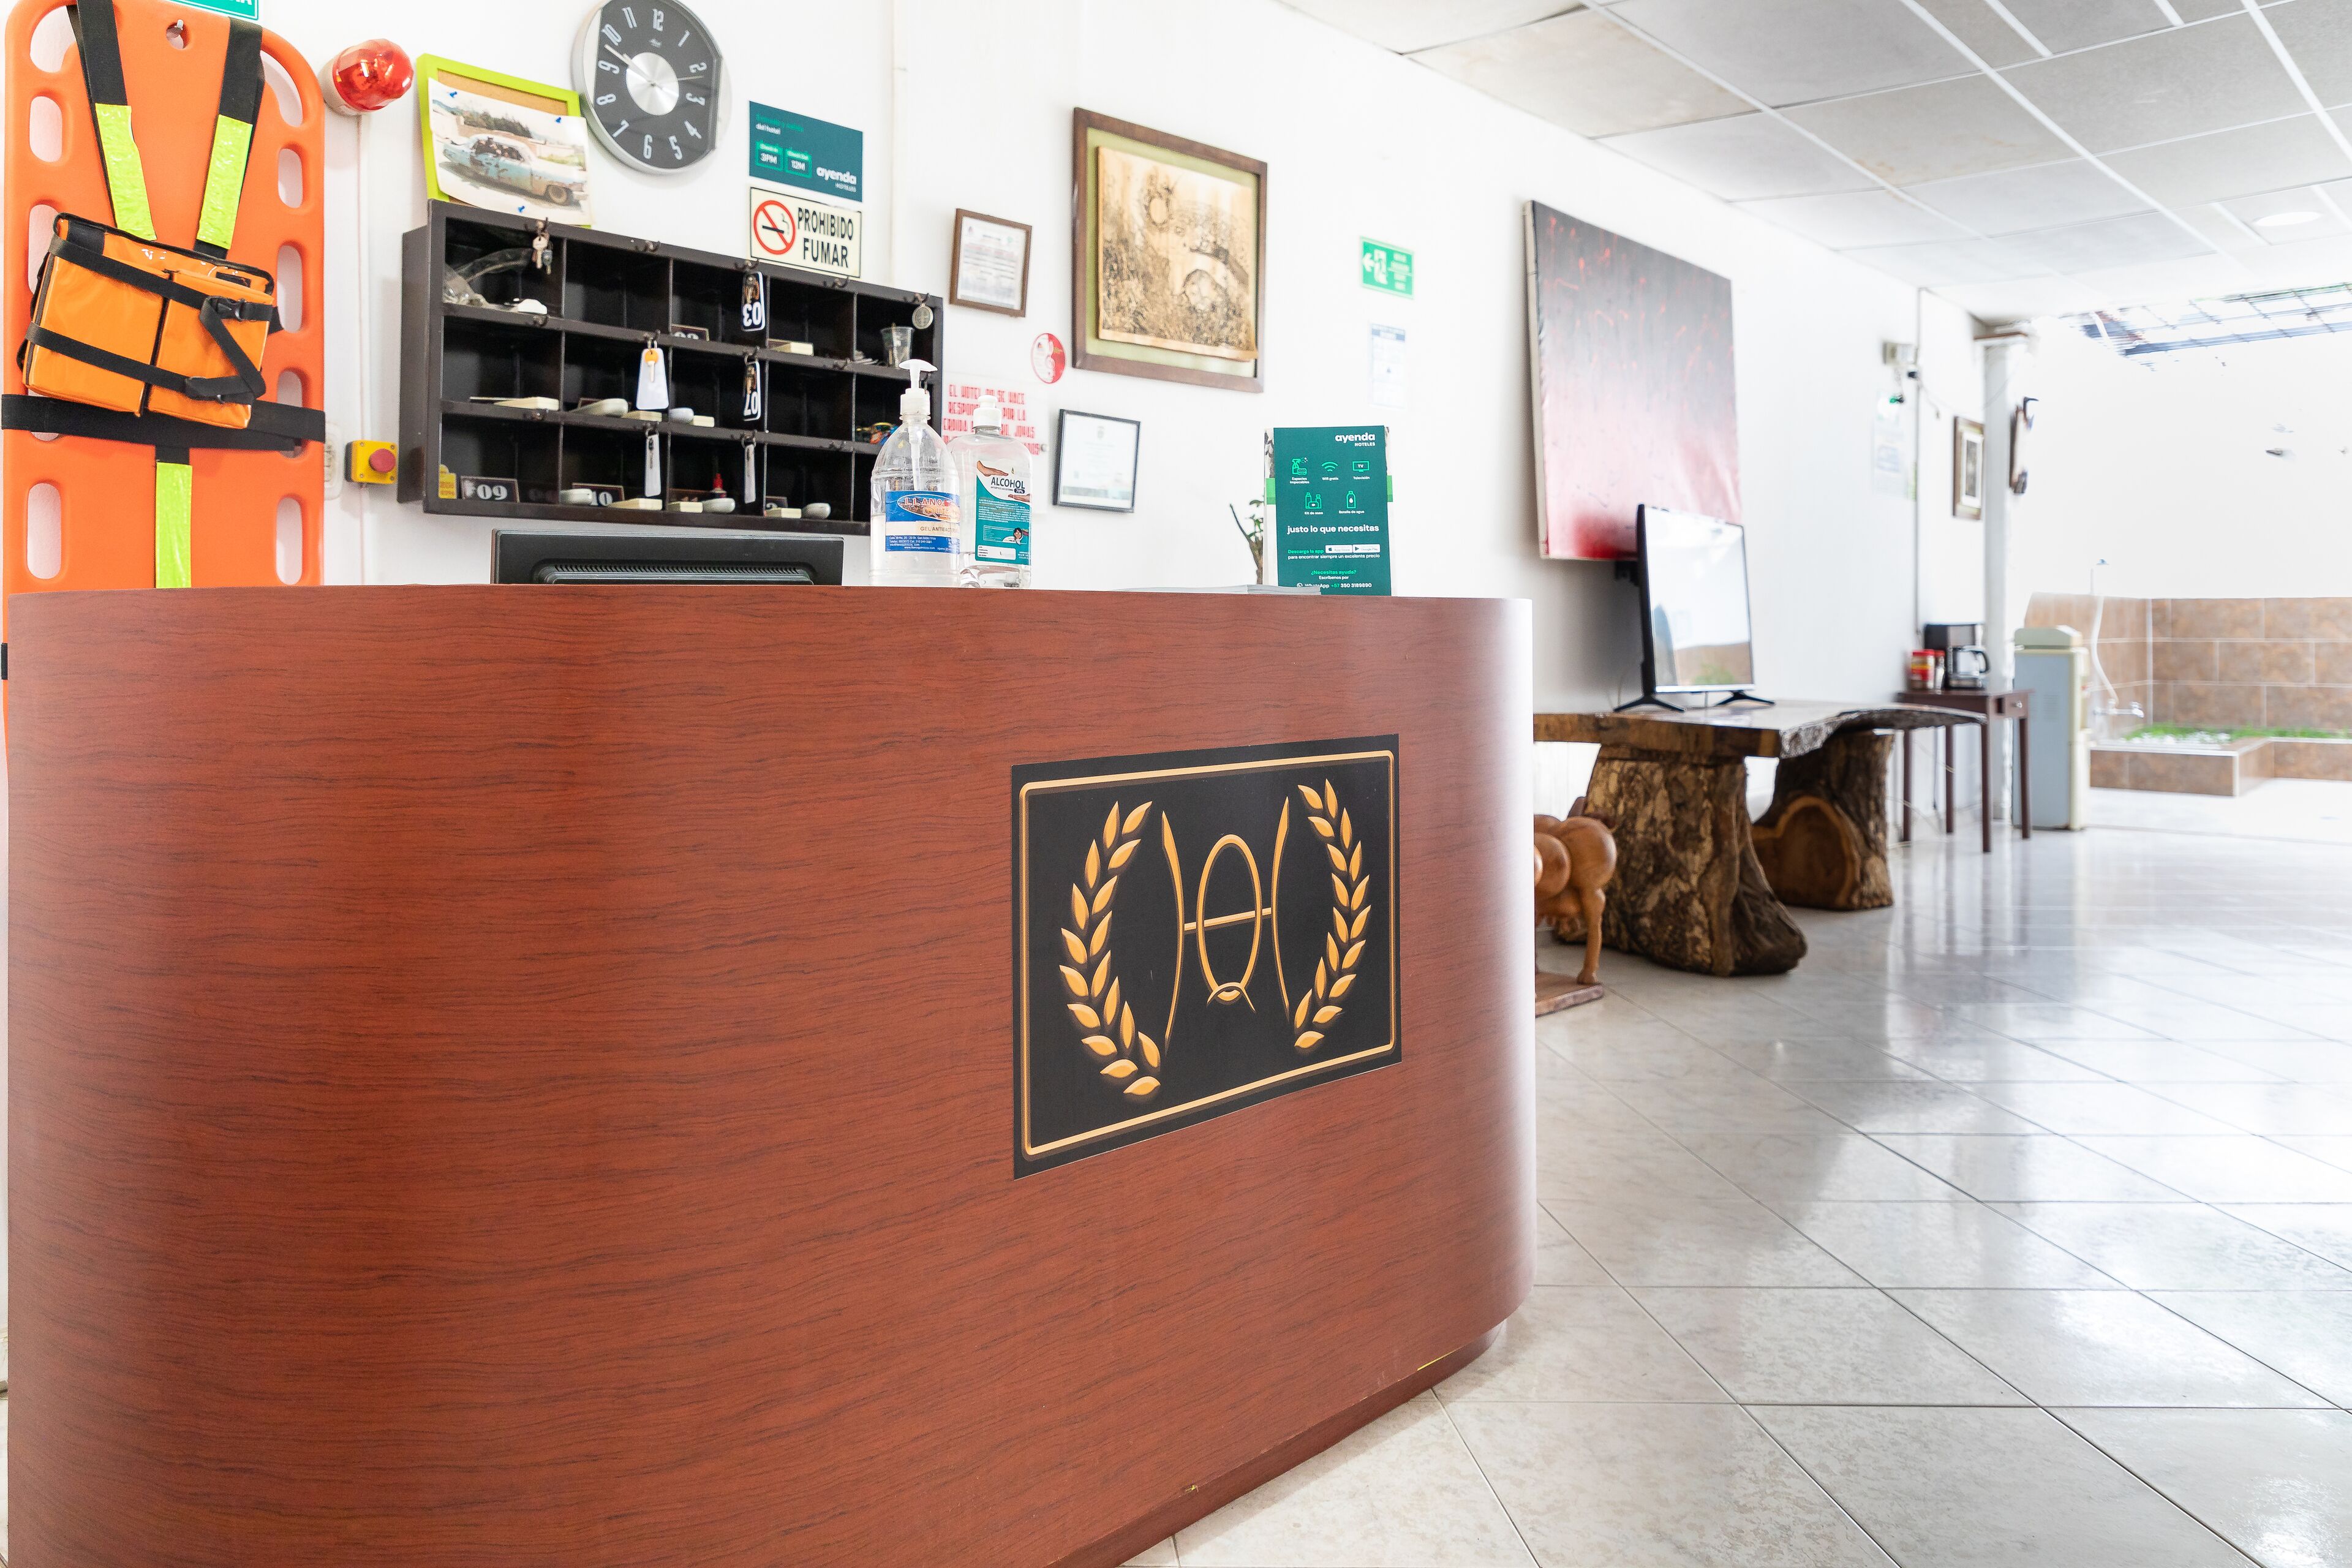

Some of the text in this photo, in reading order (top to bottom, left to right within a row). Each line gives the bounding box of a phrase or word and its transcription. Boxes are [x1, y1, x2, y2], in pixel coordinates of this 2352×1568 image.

[622, 7, 637, 28] 11
[652, 9, 664, 31] 12
[601, 23, 622, 46] 10
[678, 31, 690, 47] 1
[598, 60, 620, 74] 9
[689, 62, 707, 73] 2
[596, 93, 617, 105] 8
[685, 92, 705, 105] 3
[612, 119, 630, 138] 7
[684, 121, 701, 139] 4
[643, 134, 653, 159] 6
[668, 135, 683, 160] 5
[816, 167, 857, 185] ayenda
[798, 207, 853, 241] PROHIBIDO
[803, 238, 848, 268] FUMAR
[742, 301, 761, 327] 03
[1335, 432, 1376, 443] ayenda
[990, 477, 1025, 489] ALCOHOL
[904, 497, 943, 507] LLANO
[1287, 526, 1309, 535] justo
